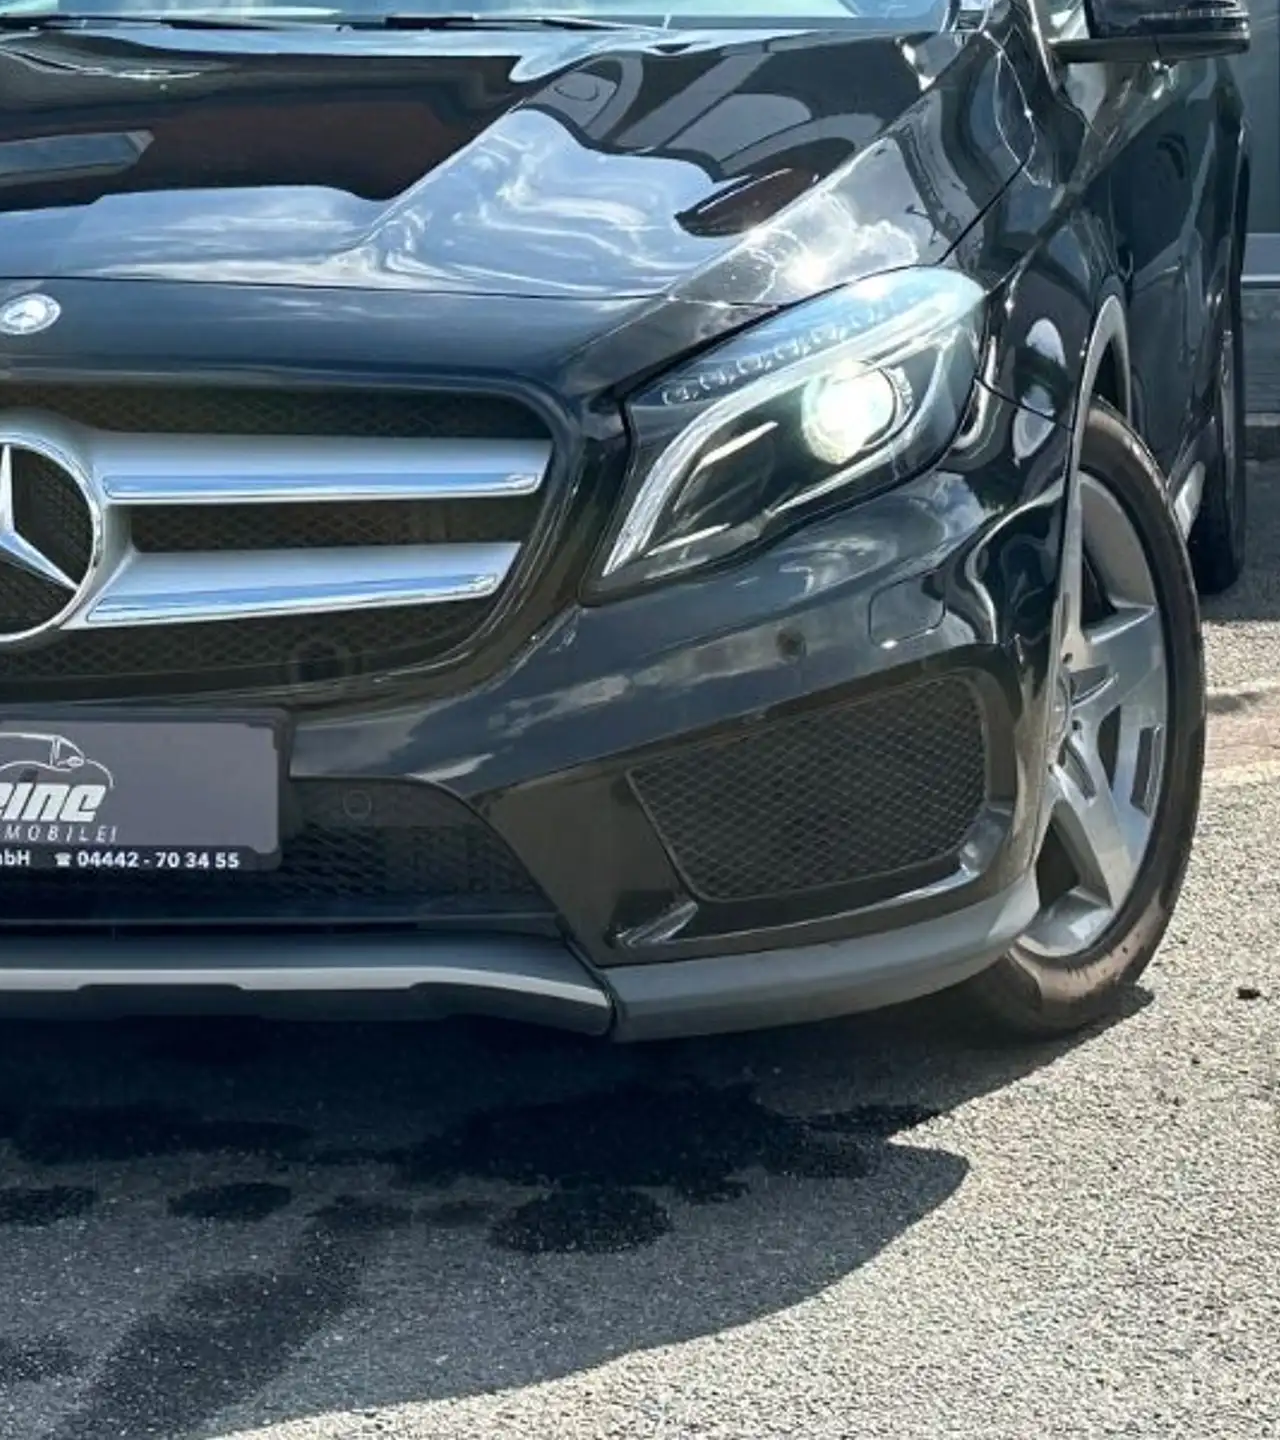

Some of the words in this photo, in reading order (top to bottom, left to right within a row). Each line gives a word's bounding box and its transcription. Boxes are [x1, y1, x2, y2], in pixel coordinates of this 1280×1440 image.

[77, 851, 140, 869] 04442
[155, 851, 180, 869] 70
[184, 851, 209, 869] 34
[215, 851, 241, 869] 55
